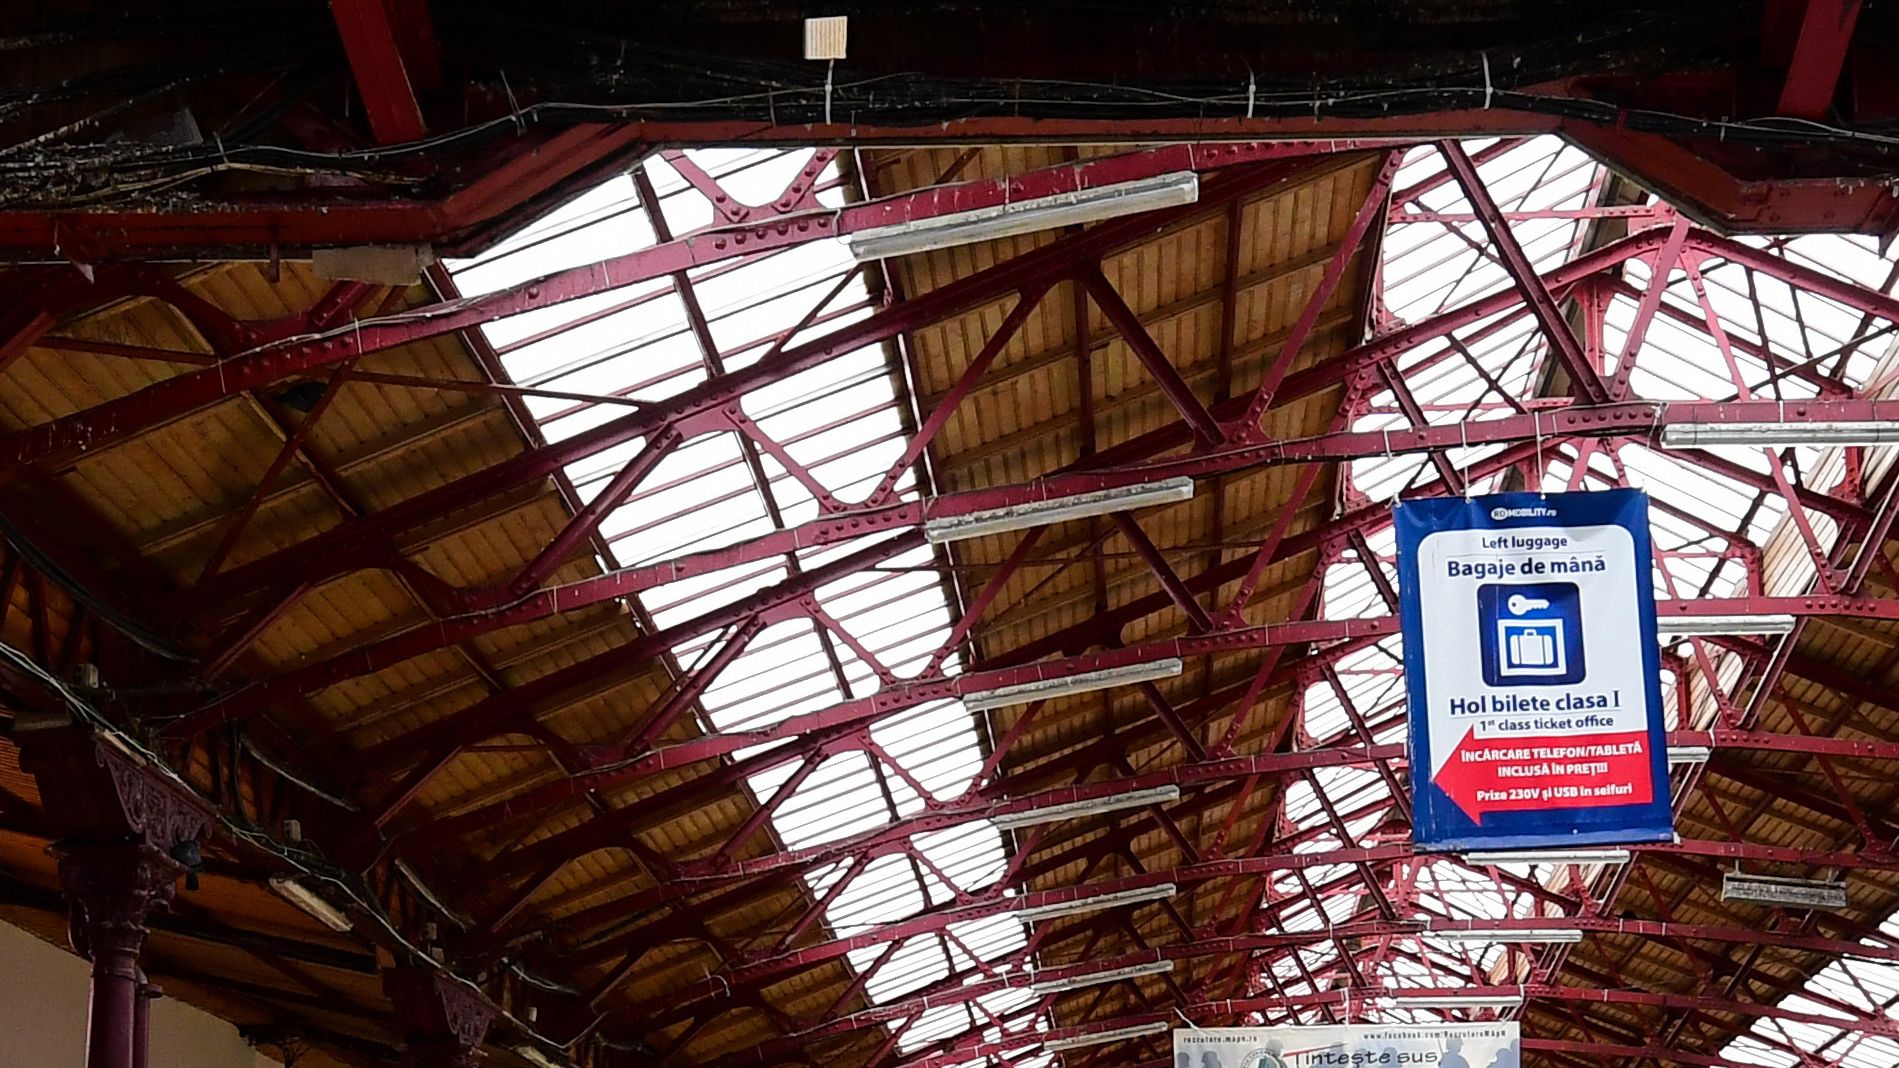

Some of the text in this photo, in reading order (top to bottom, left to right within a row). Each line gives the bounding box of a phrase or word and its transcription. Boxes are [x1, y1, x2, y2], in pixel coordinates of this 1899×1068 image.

[1482, 535, 1568, 550] Left luggage
[1447, 555, 1606, 579] Bagaje de mână
[1450, 690, 1620, 715] Hol bilete clasa I
[1499, 718, 1531, 731] class
[1534, 717, 1572, 729] ticket
[1576, 715, 1614, 727] office
[1477, 788, 1507, 801] Prize
[1509, 787, 1540, 801] 230V
[1554, 785, 1578, 799] USB
[1594, 782, 1632, 796] seifuri
